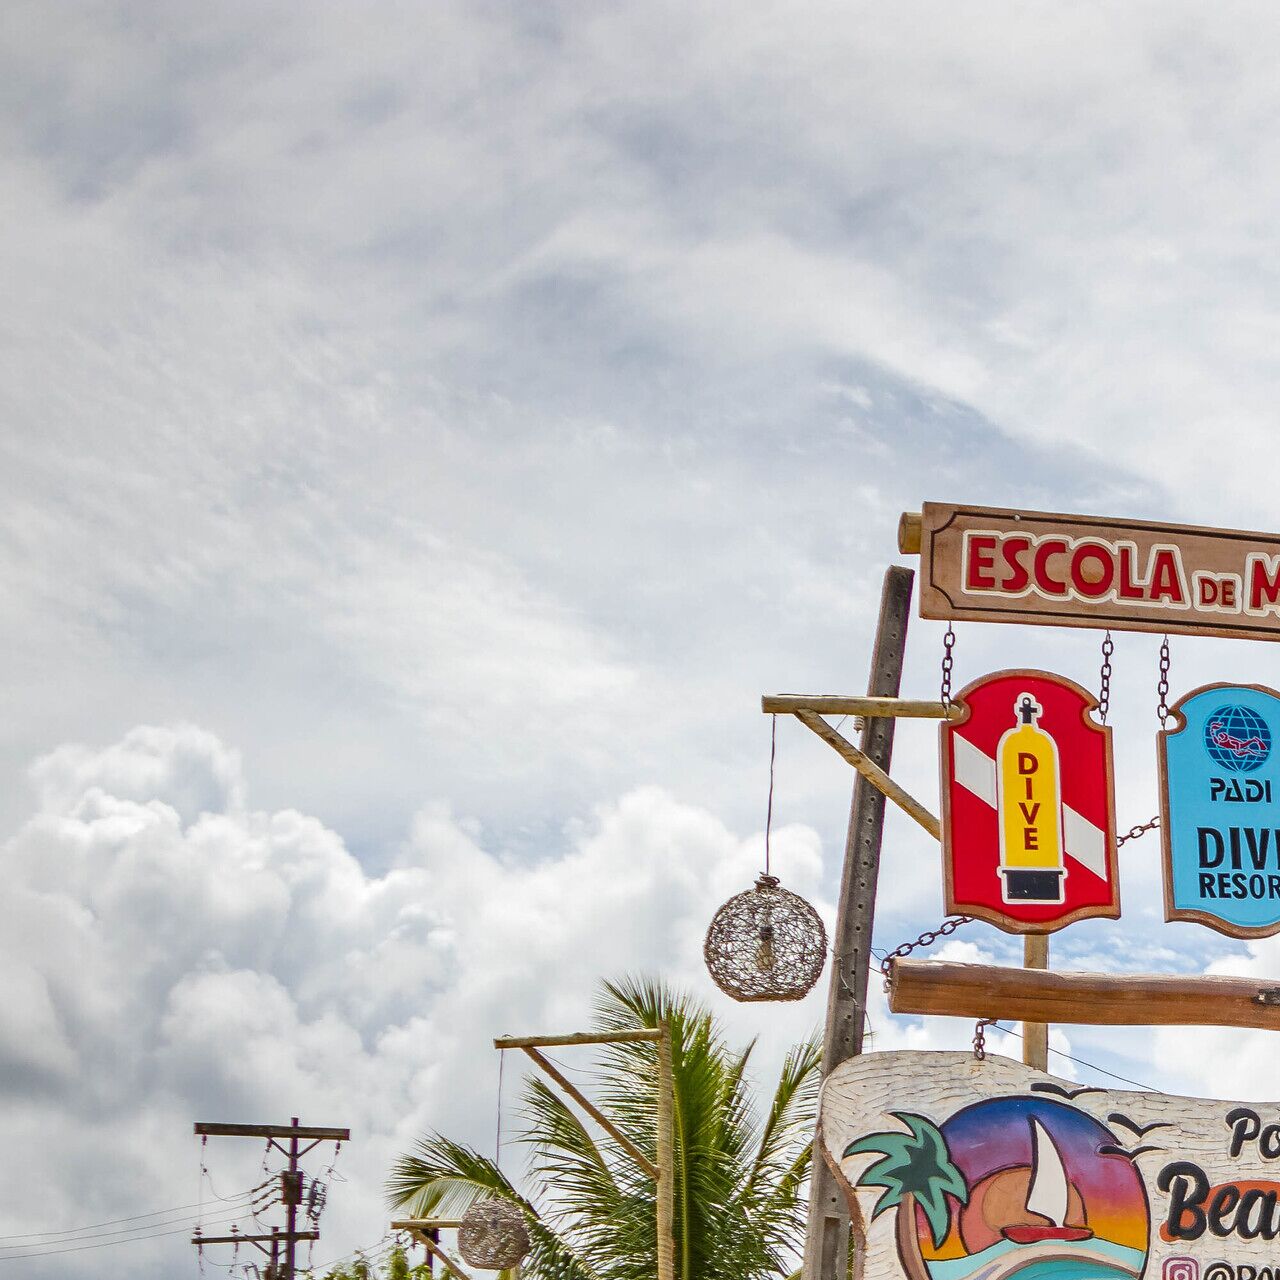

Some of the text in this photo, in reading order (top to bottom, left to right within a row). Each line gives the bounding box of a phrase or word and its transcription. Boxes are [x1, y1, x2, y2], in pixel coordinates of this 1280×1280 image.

[966, 534, 1184, 603] ESCOLA
[1199, 578, 1236, 608] DE
[1017, 751, 1041, 851] DIVE
[1209, 776, 1273, 804] PADI
